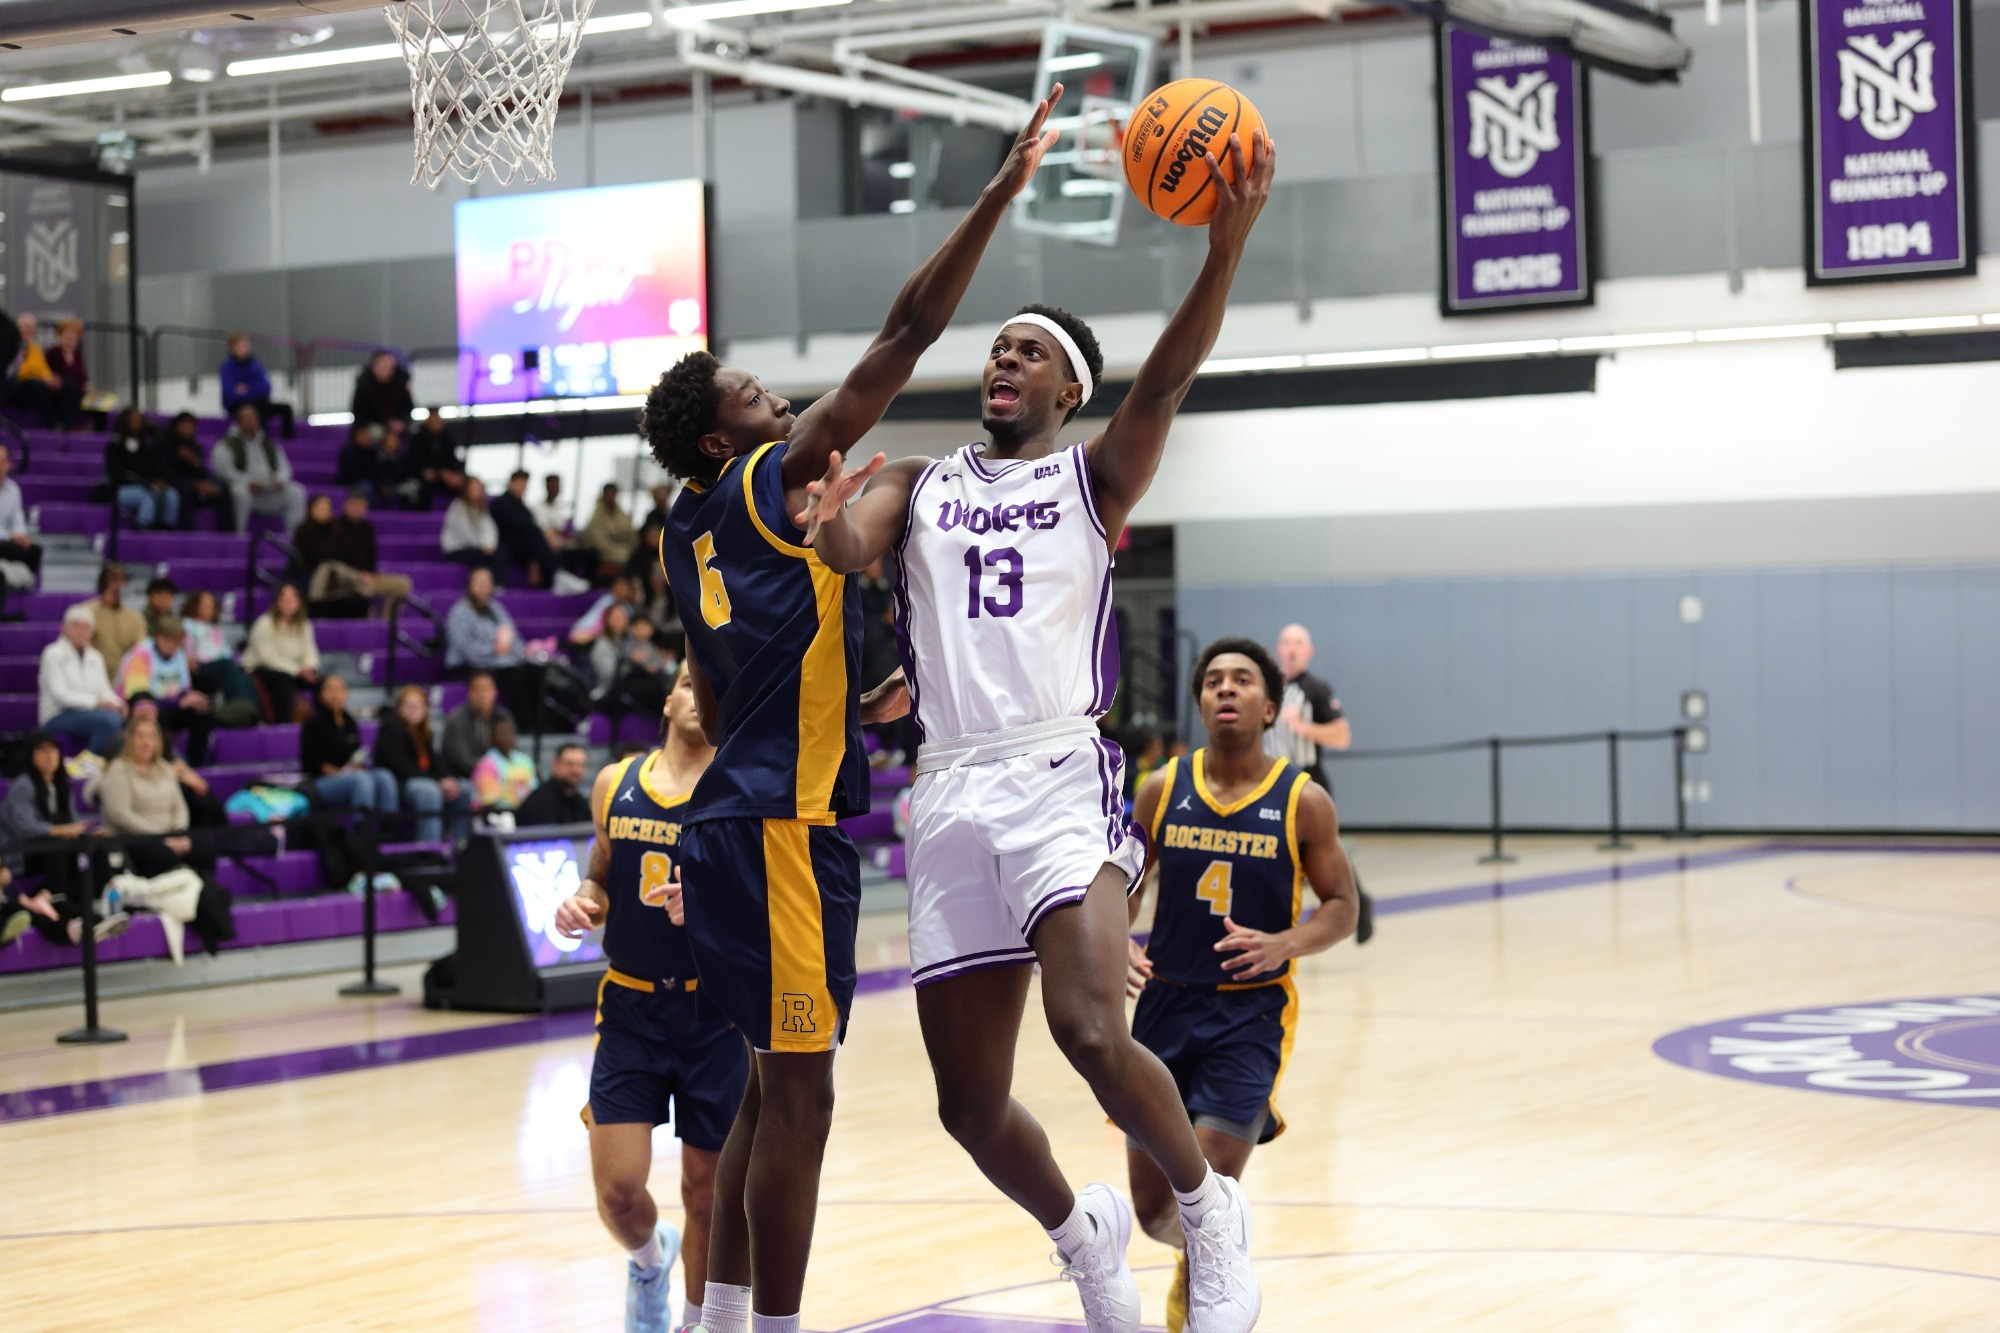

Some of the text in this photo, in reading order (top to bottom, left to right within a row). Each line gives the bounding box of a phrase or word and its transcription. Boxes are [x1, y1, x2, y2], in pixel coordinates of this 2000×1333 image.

[1160, 105, 1229, 193] Wilson
[1846, 220, 1932, 261] 1994
[1034, 463, 1061, 480] UAA
[936, 498, 1061, 536] Violets
[692, 530, 731, 630] 6
[964, 545, 1024, 619] 13
[609, 816, 682, 847] ROCHES
[1164, 824, 1278, 859] ROCHESTER
[639, 851, 672, 907] 8
[1196, 860, 1232, 916] 4
[782, 993, 815, 1033] R
